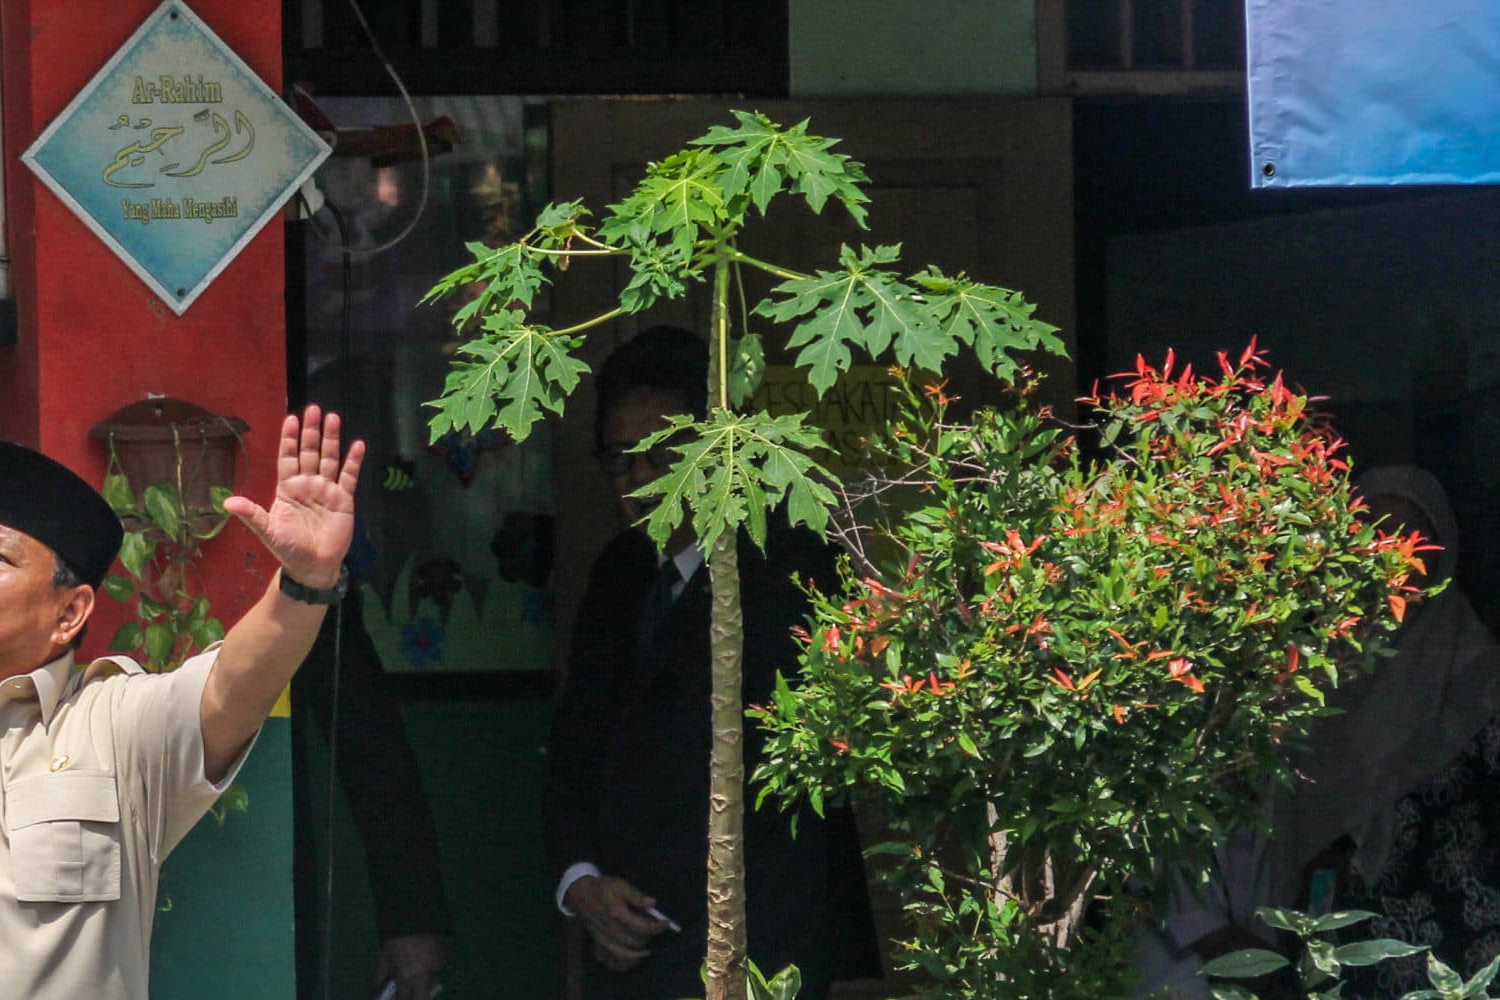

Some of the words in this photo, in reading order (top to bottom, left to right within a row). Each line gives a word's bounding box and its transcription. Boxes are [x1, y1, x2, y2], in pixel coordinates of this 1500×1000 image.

[132, 74, 222, 104] Ar-Rahim
[122, 198, 150, 225] Yang
[151, 197, 181, 220] Maha
[182, 196, 238, 224] Mengasihi
